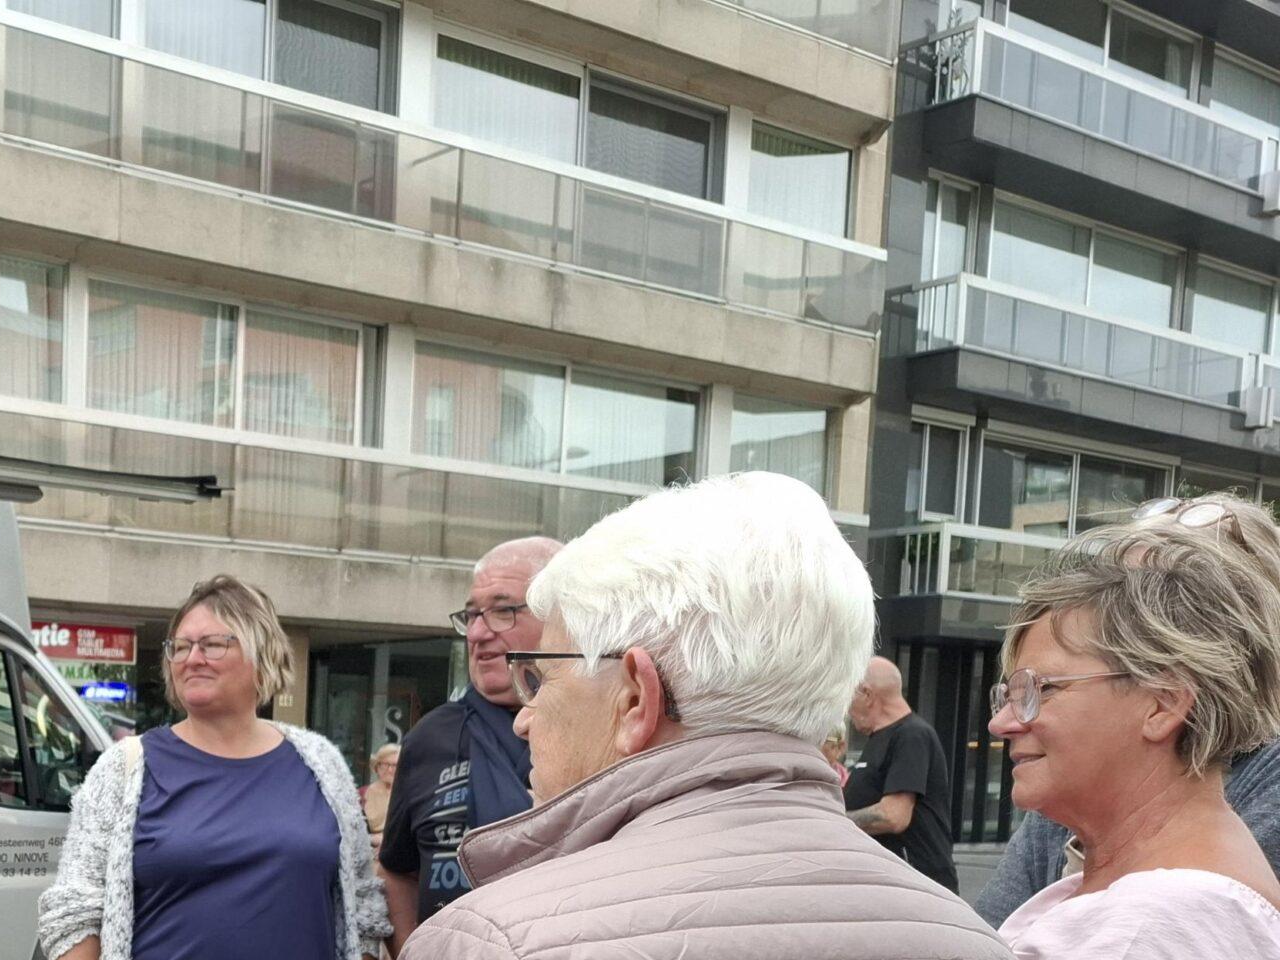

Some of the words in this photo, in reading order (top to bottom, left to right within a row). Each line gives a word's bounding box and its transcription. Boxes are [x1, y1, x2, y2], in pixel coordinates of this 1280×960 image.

[13, 852, 49, 863] NINOVE
[2, 867, 15, 877] 33
[19, 867, 31, 876] 14
[34, 867, 47, 876] 23
